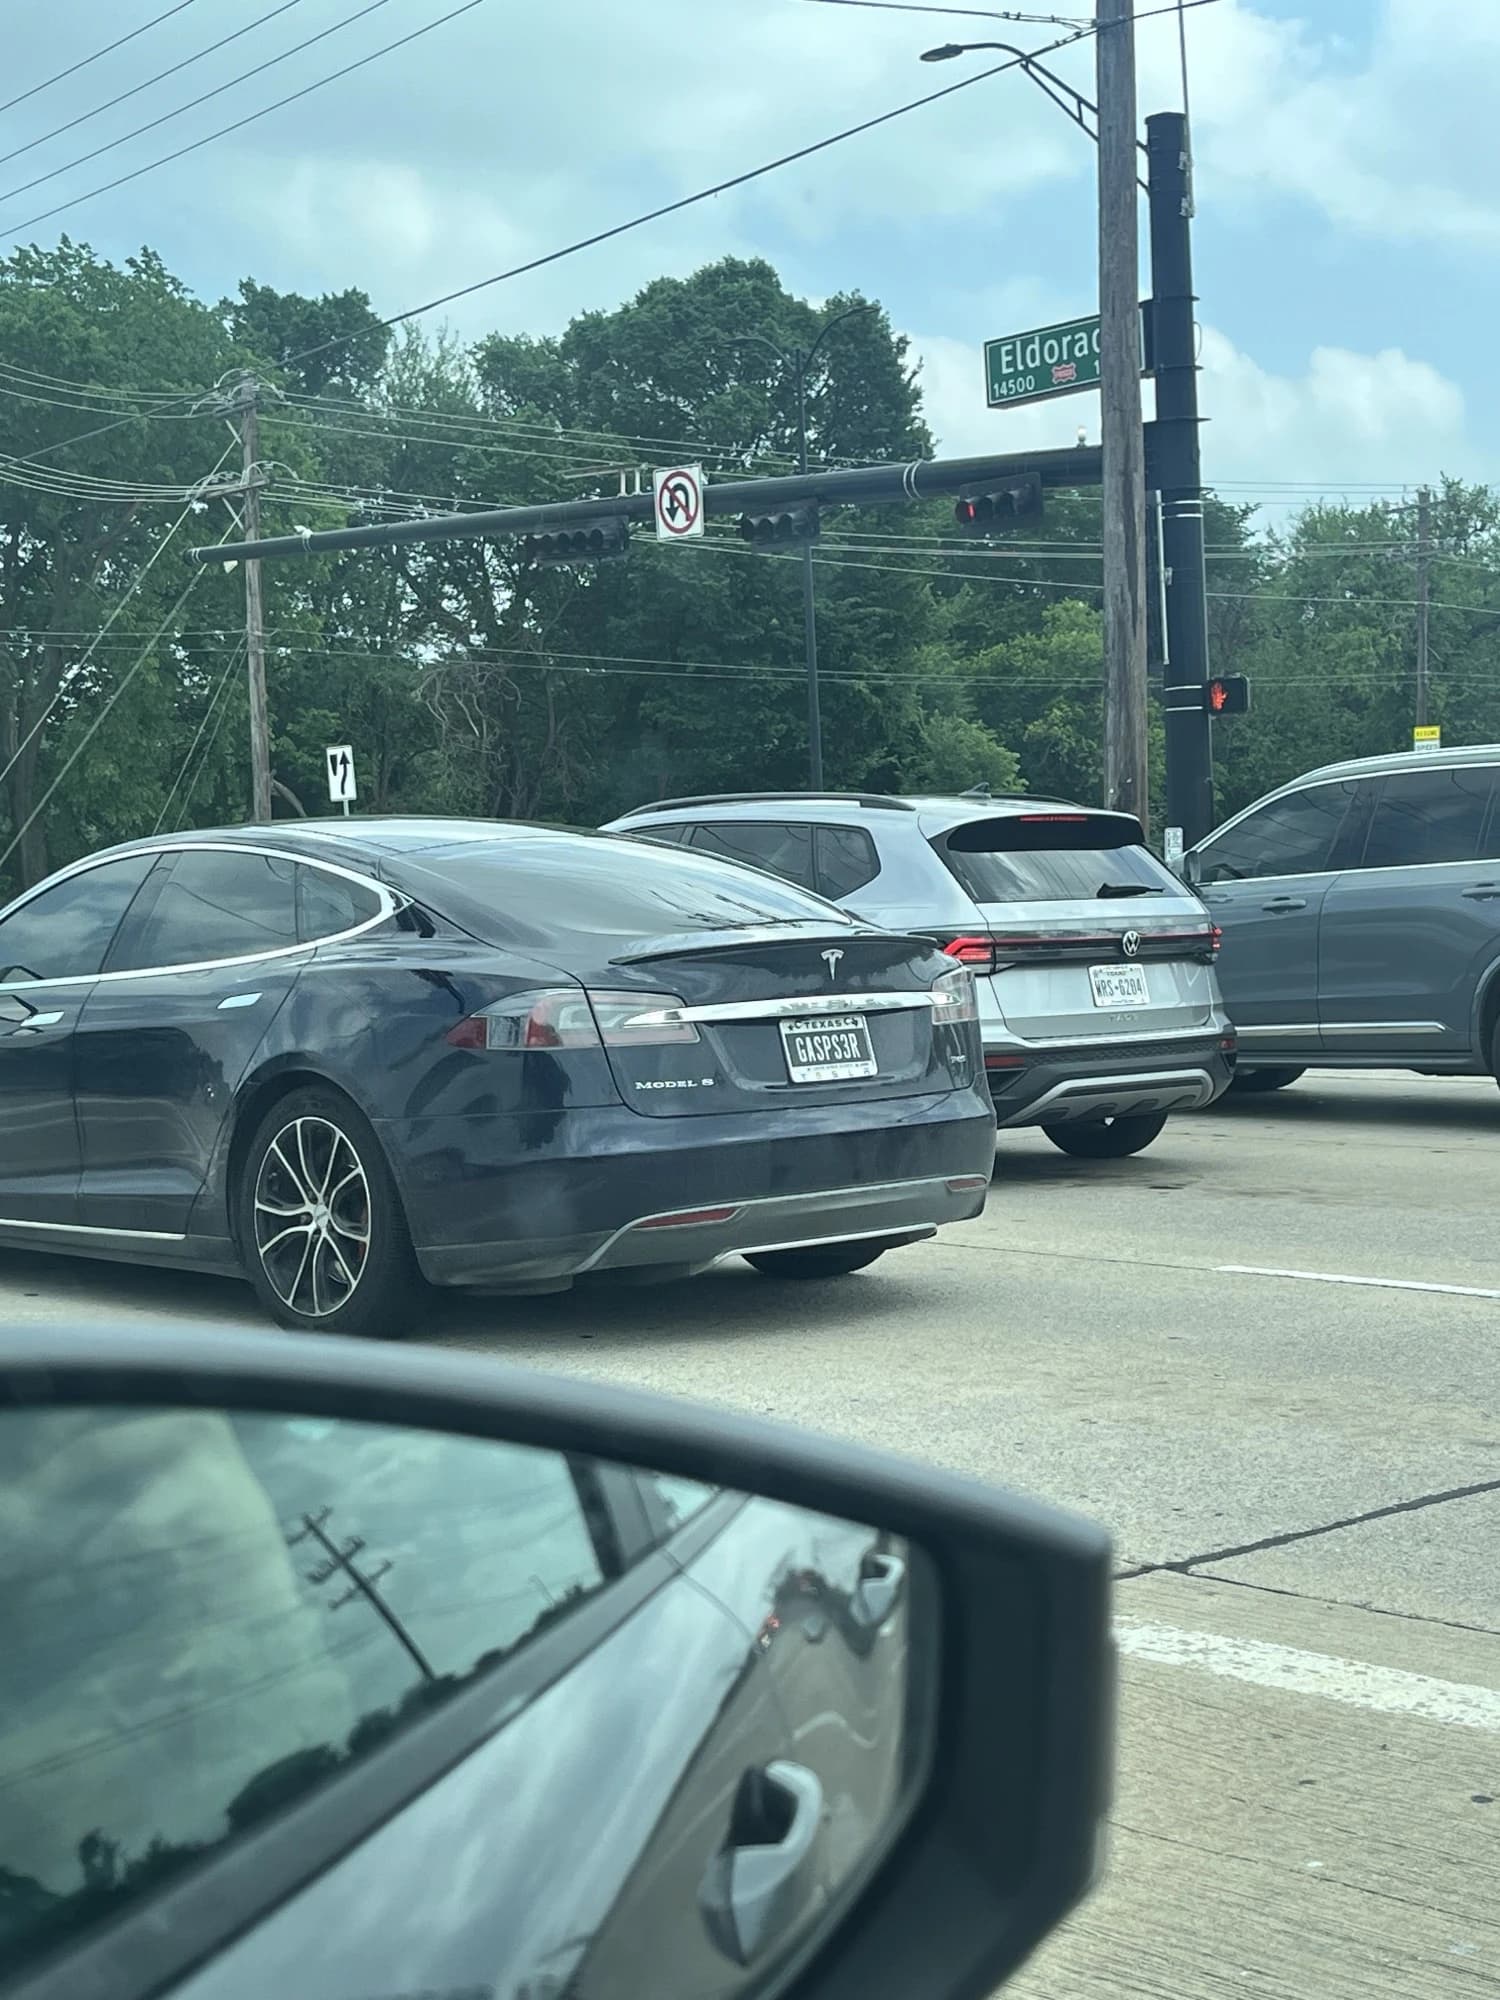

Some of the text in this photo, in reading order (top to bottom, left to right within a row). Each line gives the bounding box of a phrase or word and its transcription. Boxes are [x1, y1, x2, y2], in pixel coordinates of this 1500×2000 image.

[993, 375, 1035, 398] 14500
[804, 1019, 841, 1029] TEXAS
[795, 1033, 860, 1062] GASPS3R
[635, 1078, 714, 1090] MODEL S
